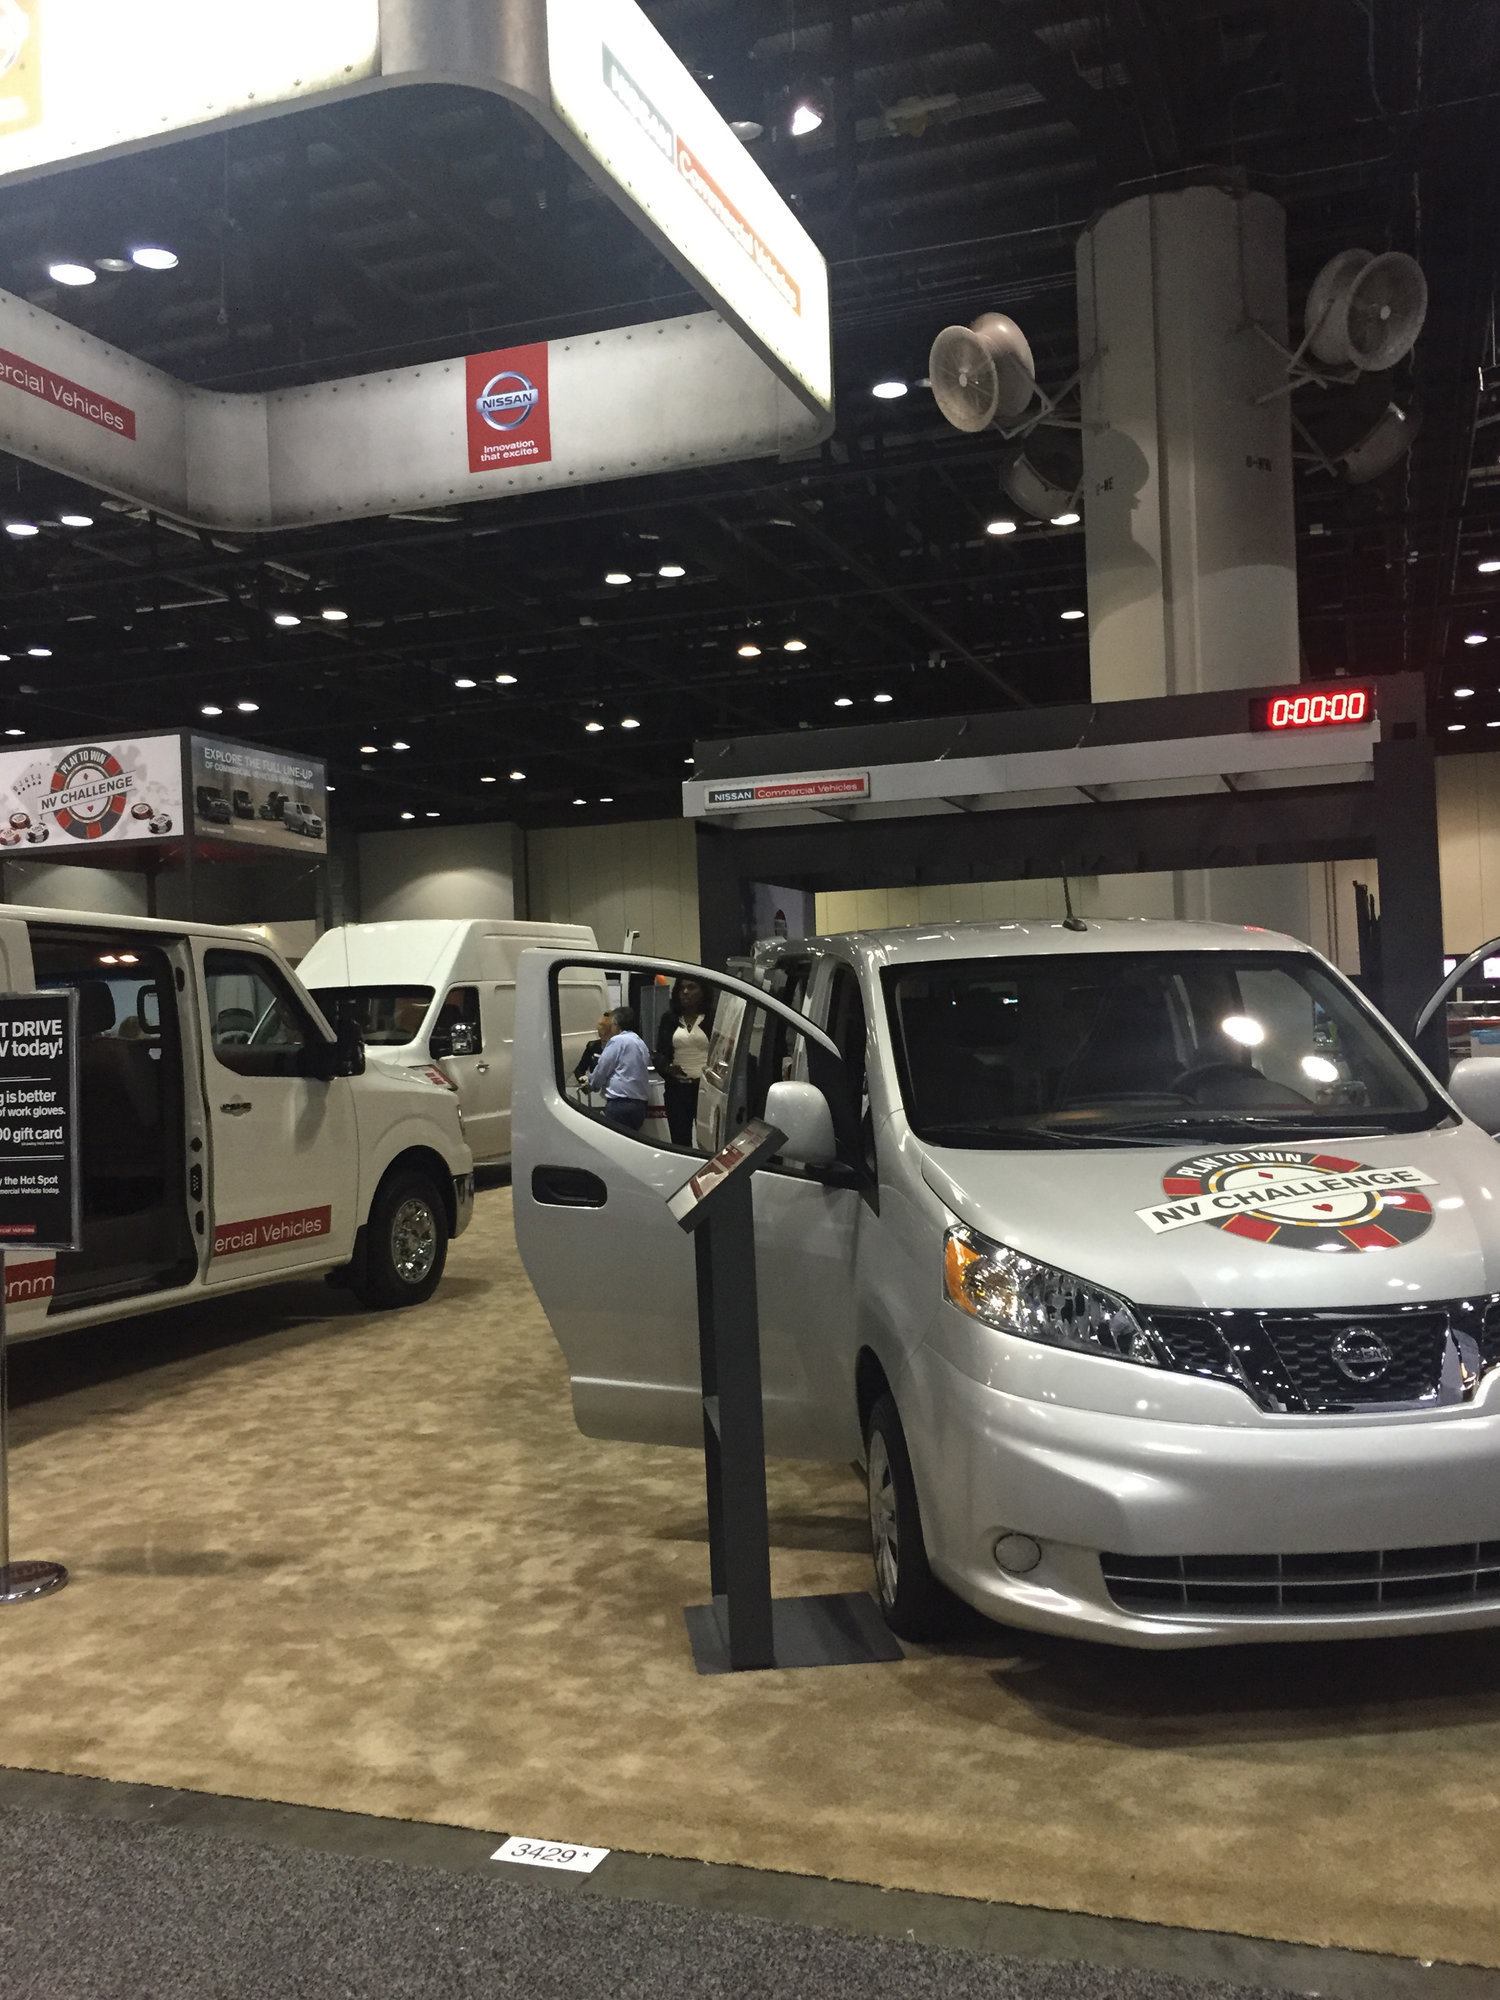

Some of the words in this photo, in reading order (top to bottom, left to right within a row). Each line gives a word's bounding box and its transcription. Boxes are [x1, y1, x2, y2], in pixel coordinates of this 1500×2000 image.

[50, 381, 124, 430] Vehicles
[482, 393, 532, 409] NISSAN
[481, 453, 500, 462] that
[503, 447, 539, 459] excites
[483, 440, 535, 453] Innovation
[1272, 692, 1366, 726] 0:00:00
[60, 753, 79, 775] PLAY
[79, 750, 89, 762] TO
[90, 750, 107, 765] WIN
[204, 747, 242, 766] EXPLORE
[245, 756, 261, 769] THE
[205, 761, 214, 769] OF
[41, 796, 58, 811] NV
[60, 775, 133, 804] CHALLENGE
[714, 791, 751, 802] NISSAN
[757, 785, 815, 798] Commercial
[818, 783, 858, 793] Vehicles
[0, 1022, 9, 1037] T
[12, 1019, 63, 1037] DRIVE
[11, 1037, 63, 1059] today!
[6, 1090, 17, 1103] is
[18, 1089, 57, 1103] better
[8, 1105, 31, 1117] work
[33, 1105, 66, 1118] gloves.
[13, 1127, 34, 1143] gift
[35, 1126, 63, 1140] card
[1176, 1157, 1223, 1177] PLAY
[1215, 1153, 1251, 1163] TO
[1249, 1152, 1302, 1163] WIN
[4, 1176, 18, 1185] the
[20, 1175, 36, 1185] Hot
[37, 1174, 58, 1186] Spot
[1152, 1202, 1202, 1225] NV
[1212, 1169, 1423, 1209] CHALLENGE
[214, 1228, 257, 1252] ercial
[262, 1218, 321, 1242] Vehicles
